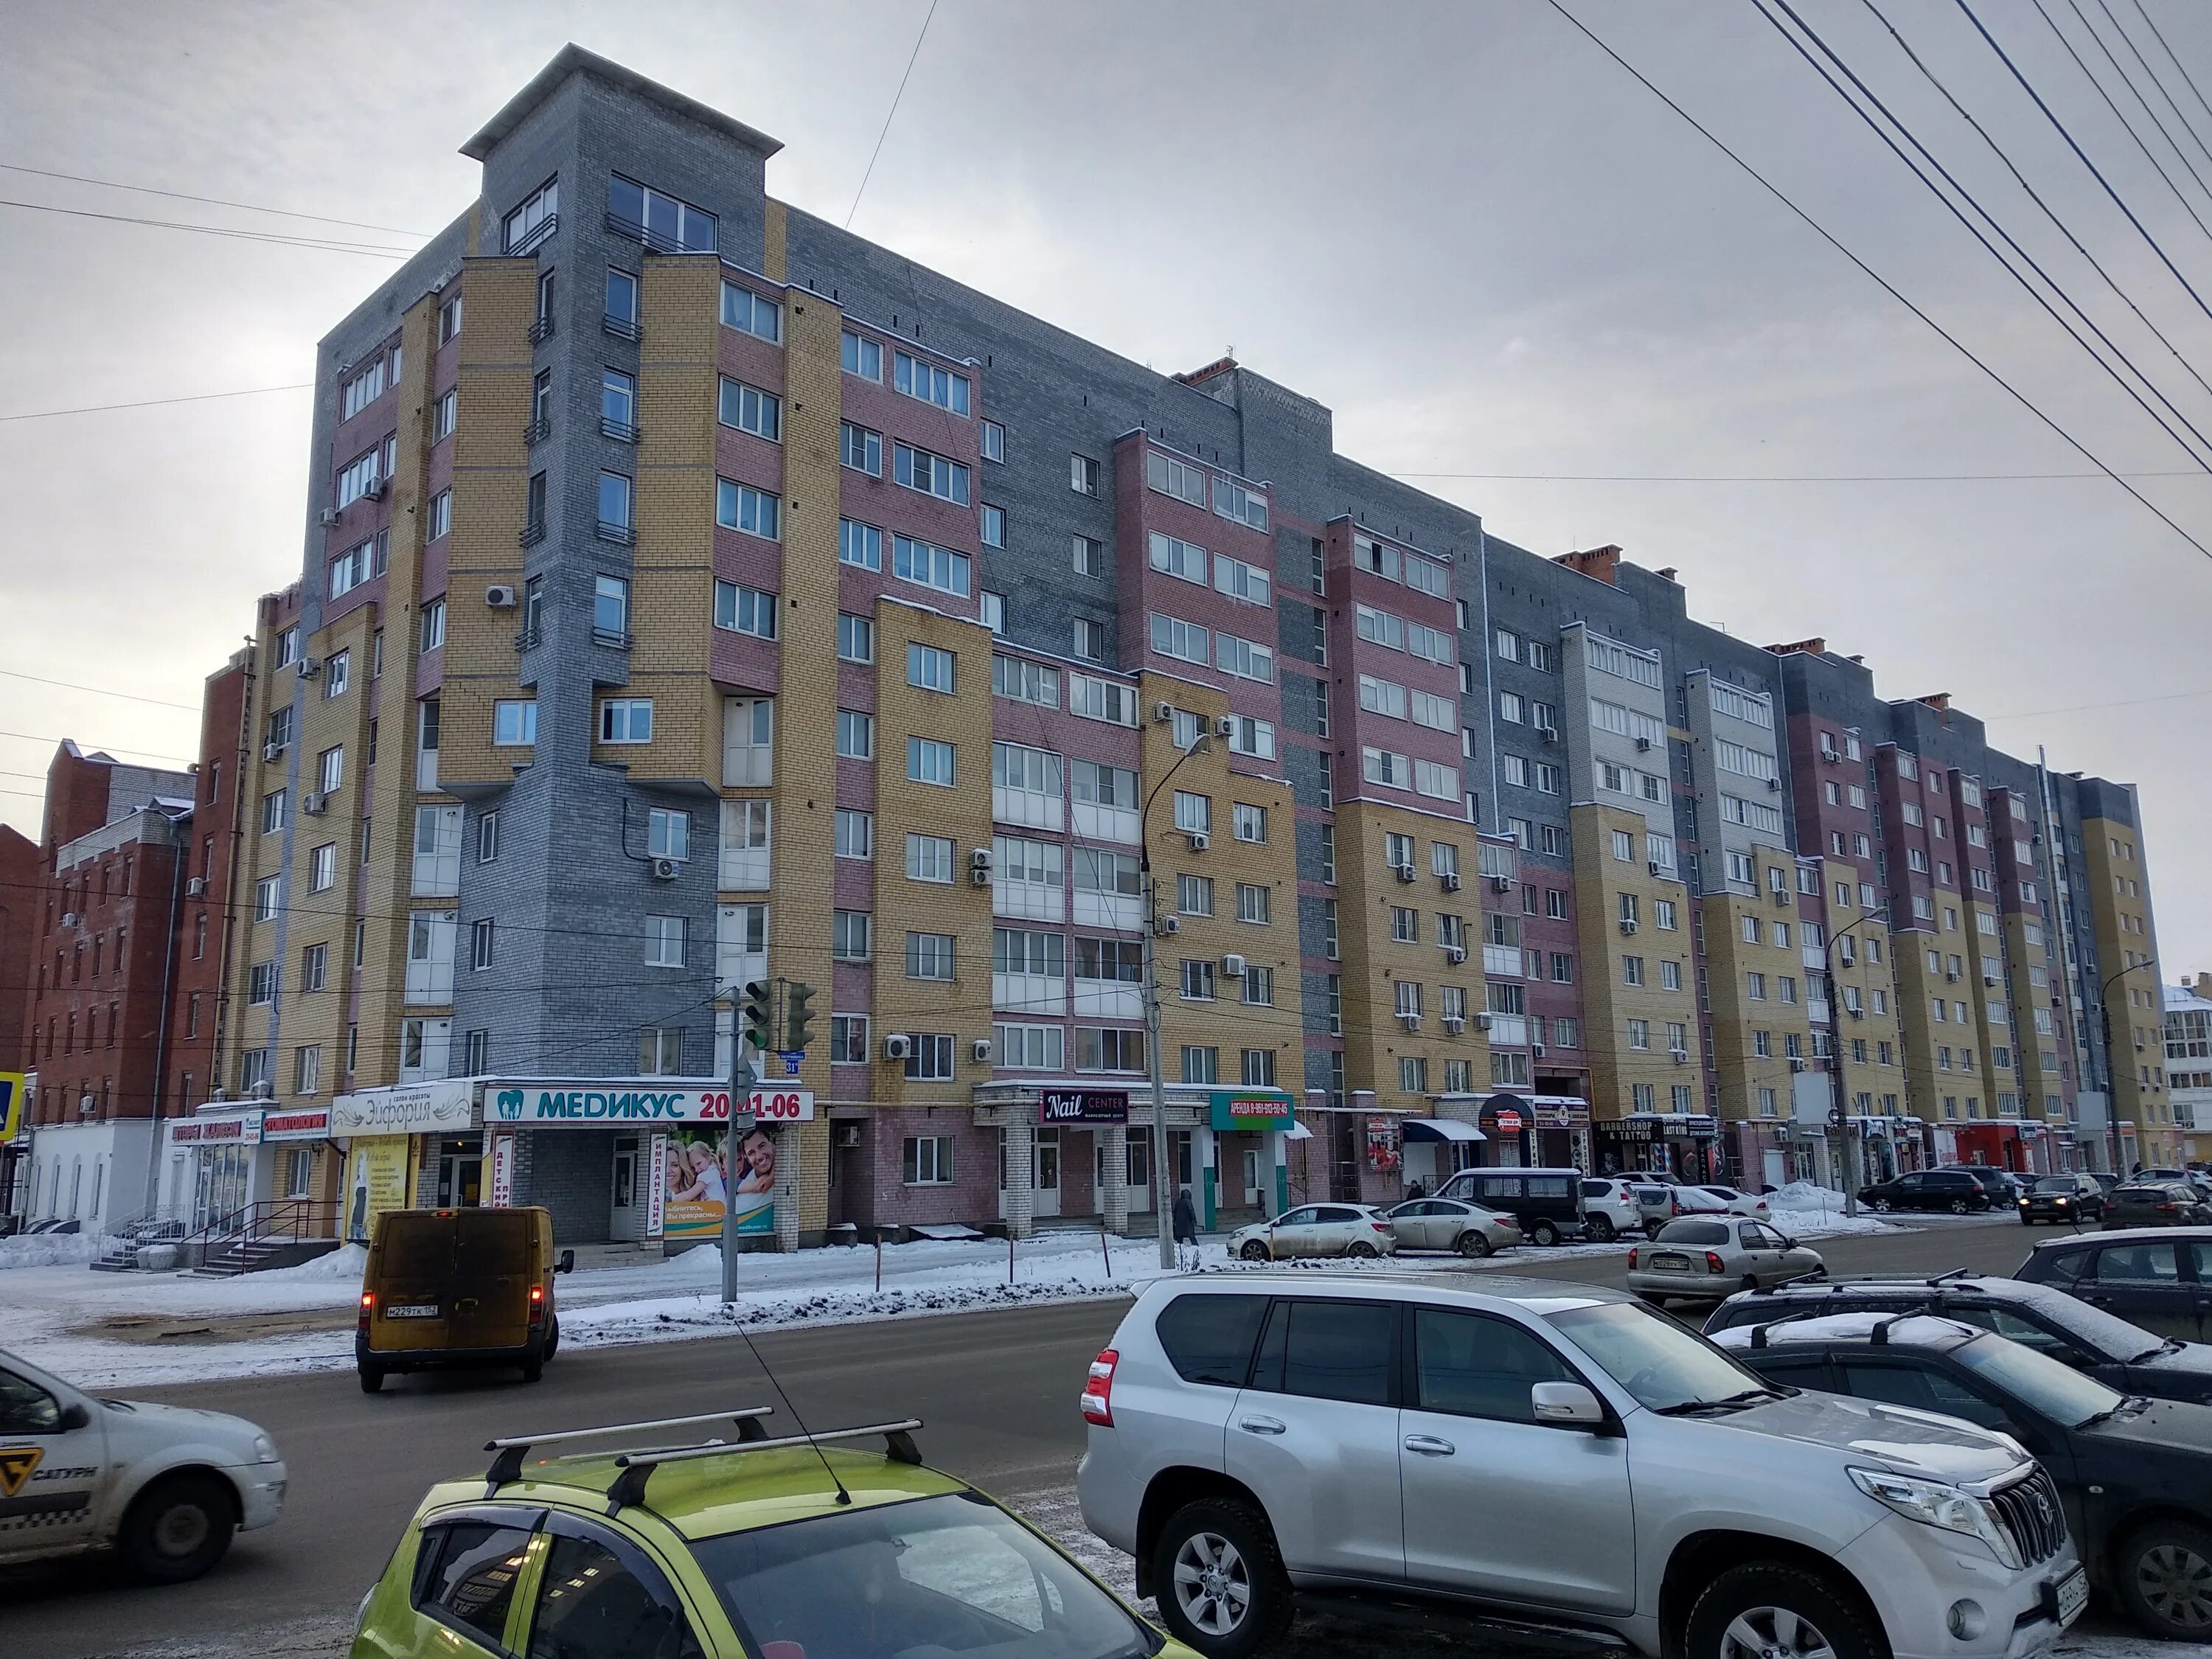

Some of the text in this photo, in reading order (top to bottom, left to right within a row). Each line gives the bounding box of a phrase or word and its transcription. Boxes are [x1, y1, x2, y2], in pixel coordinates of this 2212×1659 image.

[409, 1093, 431, 1102] красоты
[700, 1093, 800, 1118] 201-06
[1046, 1094, 1124, 1119] Nail CENTER
[1230, 1102, 1288, 1114] АРЕНДА 8-951-913-50-45
[366, 1099, 431, 1132] Эйфория
[1600, 1121, 1652, 1131] BARBERSHOP
[1610, 1131, 1652, 1141] & TATTOO
[495, 1152, 503, 1207] ДЕТСКИЙ
[653, 1143, 662, 1226] ИМПЛАНТАЦИЯ
